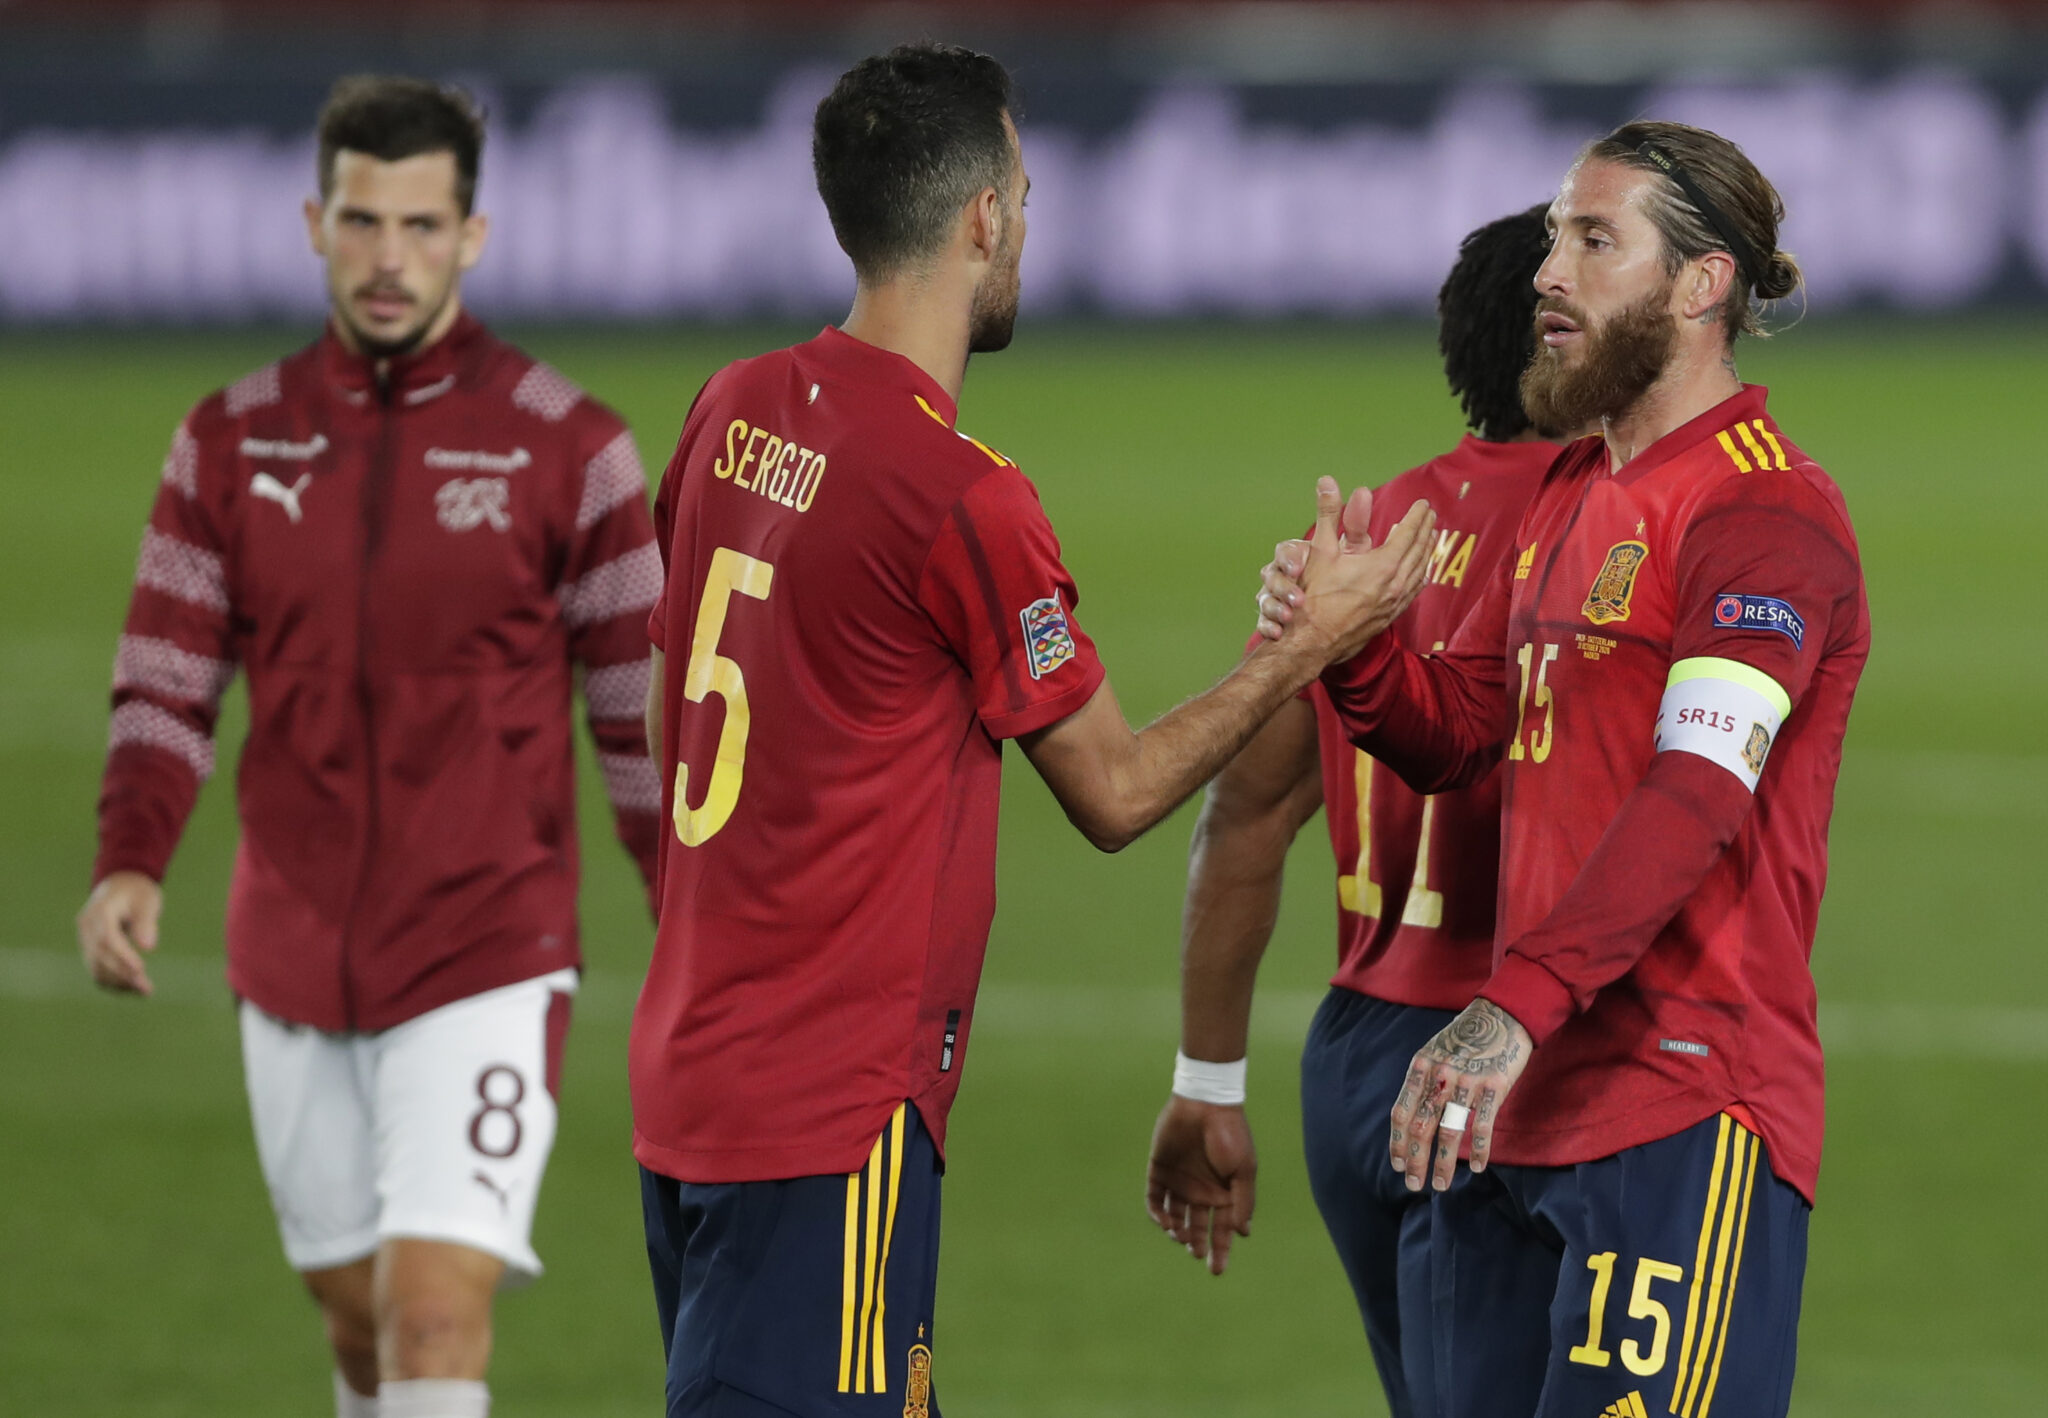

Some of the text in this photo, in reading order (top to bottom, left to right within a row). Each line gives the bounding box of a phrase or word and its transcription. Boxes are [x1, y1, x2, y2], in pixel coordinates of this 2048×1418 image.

[1648, 150, 1672, 170] SR15
[713, 418, 827, 512] SERGIO
[1425, 529, 1477, 587] MA
[1744, 604, 1804, 641] RESPECT
[672, 546, 775, 848] 5
[1508, 642, 1560, 764] 15
[1677, 707, 1736, 733] SR15
[467, 1062, 526, 1159] 8
[1568, 1251, 1684, 1377] 15
